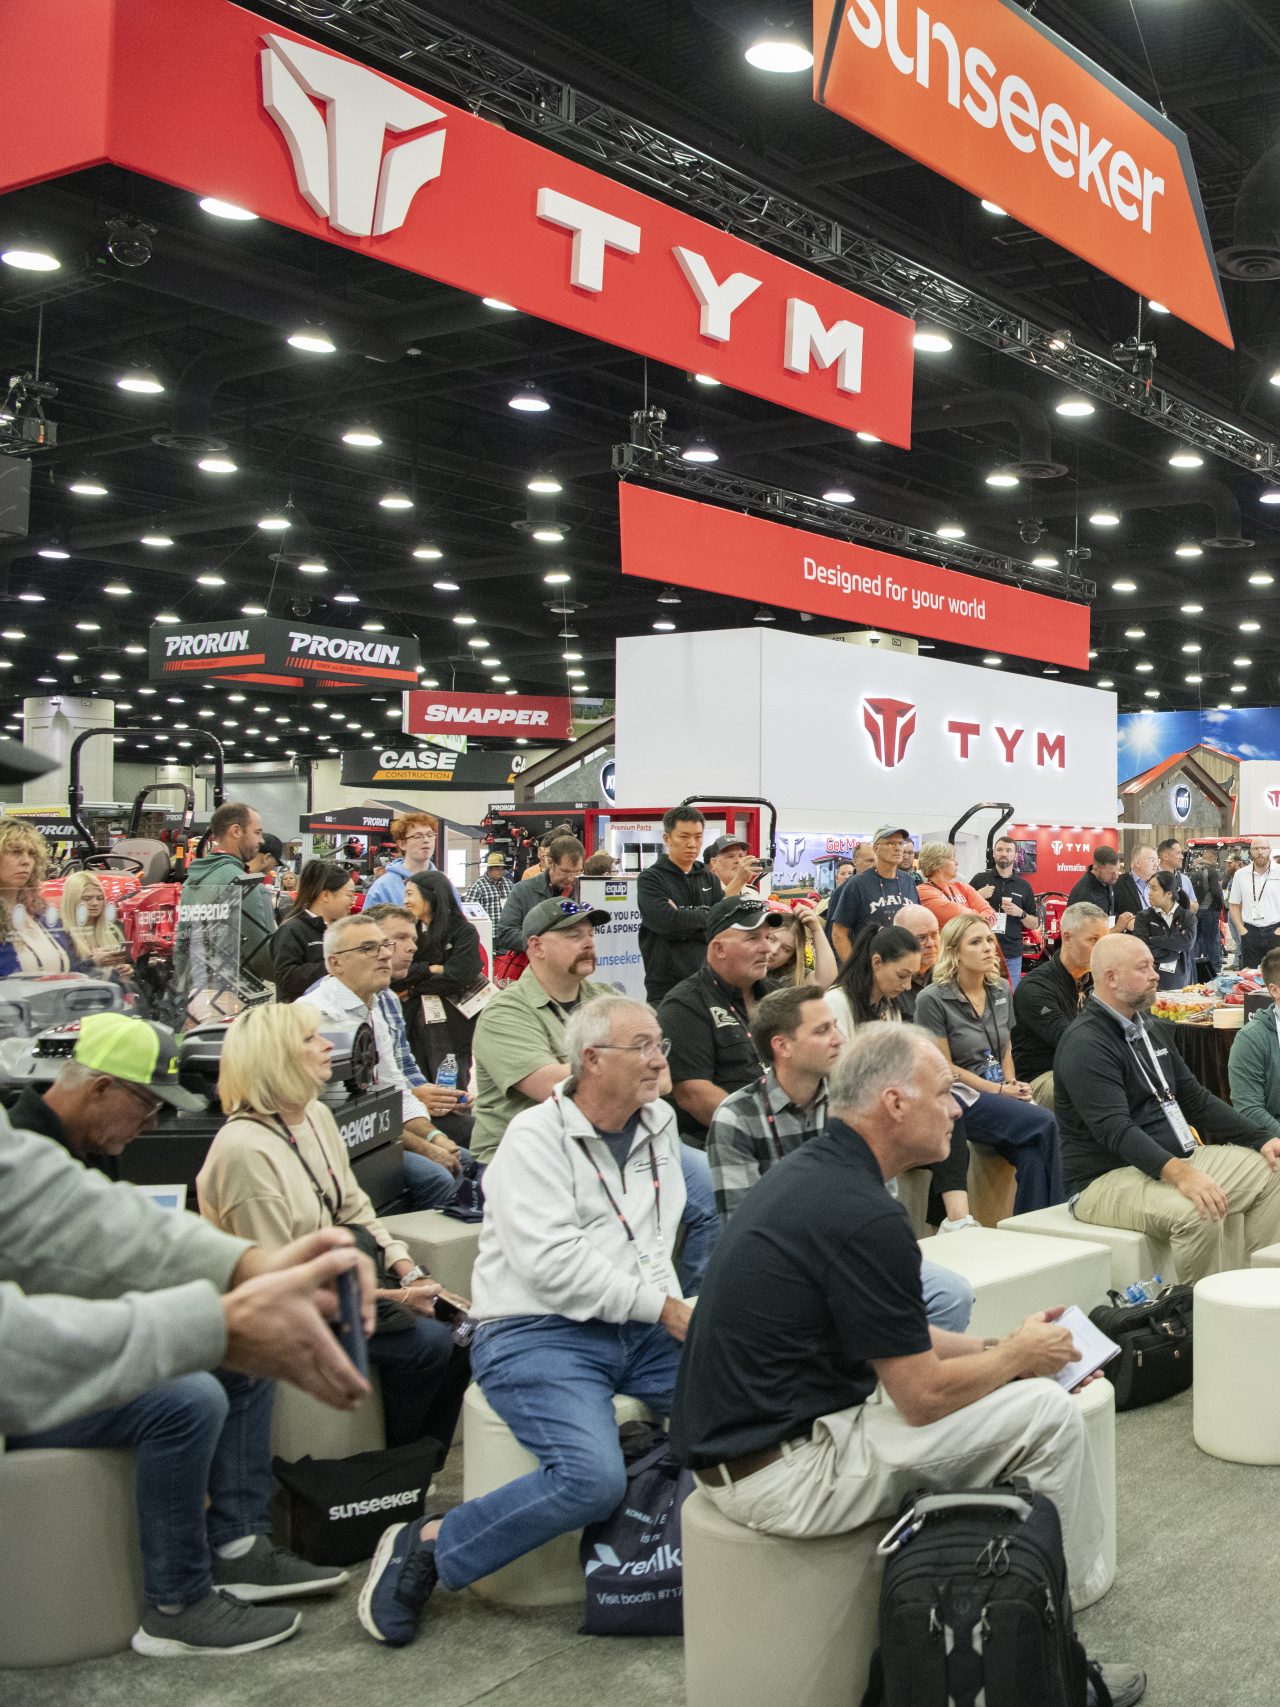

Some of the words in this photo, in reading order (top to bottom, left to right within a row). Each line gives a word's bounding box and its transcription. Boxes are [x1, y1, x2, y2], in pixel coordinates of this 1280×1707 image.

[846, 0, 1165, 235] sunseeker
[537, 187, 864, 394] TYM
[803, 556, 882, 597] Designed
[885, 577, 909, 602] for
[911, 588, 945, 610] your
[947, 598, 986, 620] world
[164, 629, 249, 657] PRORUN
[288, 631, 400, 665] PRORUN
[424, 704, 549, 726] SNAPPER
[947, 720, 1066, 769] TYM
[379, 751, 458, 770] CASE
[385, 771, 450, 780] CONSTRUCTION
[36, 825, 79, 835] ORUN
[825, 838, 845, 853] Get
[1066, 843, 1090, 852] TYM
[1056, 863, 1087, 872] Information
[606, 882, 627, 895] equip
[613, 911, 629, 920] YOU
[630, 910, 641, 920] FO
[606, 925, 612, 934] A
[596, 951, 642, 966] unseeker
[340, 1111, 377, 1147] eeker
[328, 1488, 422, 1520] sunseeker
[596, 1592, 620, 1604] Visit
[621, 1591, 655, 1604] booth
